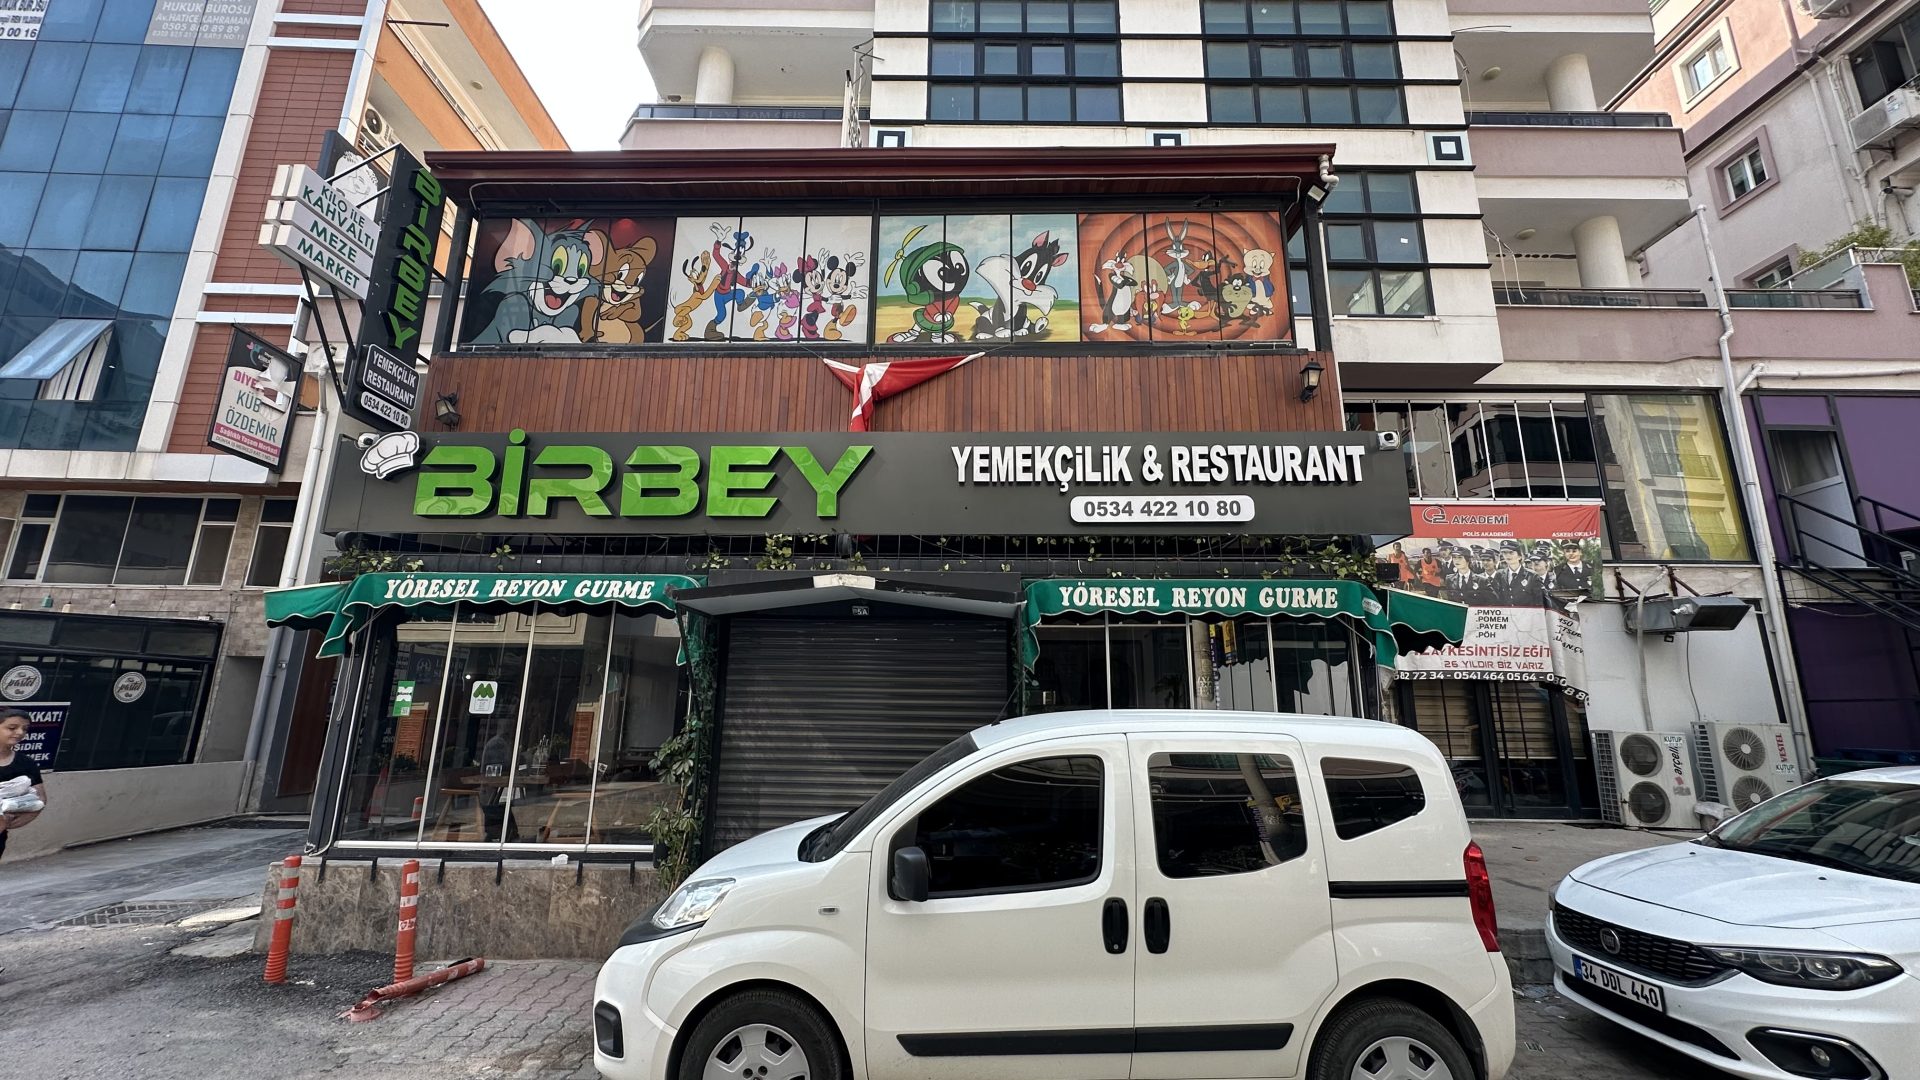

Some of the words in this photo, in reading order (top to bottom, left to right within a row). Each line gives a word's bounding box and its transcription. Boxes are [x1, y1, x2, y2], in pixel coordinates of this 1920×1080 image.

[7, 27, 21, 37] 00
[25, 28, 38, 38] 16
[302, 185, 375, 250] KAHVALTI
[310, 220, 358, 263] MEZE
[297, 238, 360, 289] MARKET
[233, 369, 258, 390] DİYE
[366, 369, 415, 406] RESTAURANT
[363, 394, 380, 411] 0534
[380, 404, 392, 417] 422
[225, 405, 278, 443] ÖZDEMİR
[1142, 444, 1164, 483] &
[1171, 444, 1365, 483] RESTAURANT
[1083, 500, 1134, 518] 0534
[1140, 500, 1178, 518] 422
[1185, 500, 1209, 518] 10
[1216, 500, 1242, 518] 80
[1451, 513, 1510, 525] AKADEMİ
[1481, 530, 1515, 538] AKADEMİSİ
[384, 574, 480, 599] YÖRESEL
[489, 579, 567, 598] REYON
[574, 580, 655, 600] GURME
[1059, 581, 1160, 607] YÖRESEL
[1171, 586, 1247, 608] REYON
[1258, 587, 1338, 609] GURME
[1447, 644, 1521, 658] KESİNTİSİZ
[1412, 671, 1427, 680] 72
[1429, 671, 1445, 680] 34
[1453, 671, 1480, 680] 0541
[1483, 671, 1505, 681] 464
[1506, 672, 1521, 680] 05
[1522, 672, 1537, 681] 64
[1444, 660, 1459, 668] 26
[1462, 660, 1495, 669] YILDIR
[1497, 659, 1513, 669] BİZ
[1516, 661, 1544, 670] VARIZ
[1775, 733, 1788, 763] VESTEL
[1581, 962, 1597, 984] 34
[1600, 969, 1627, 995] DDL
[1631, 980, 1659, 1008] 440
